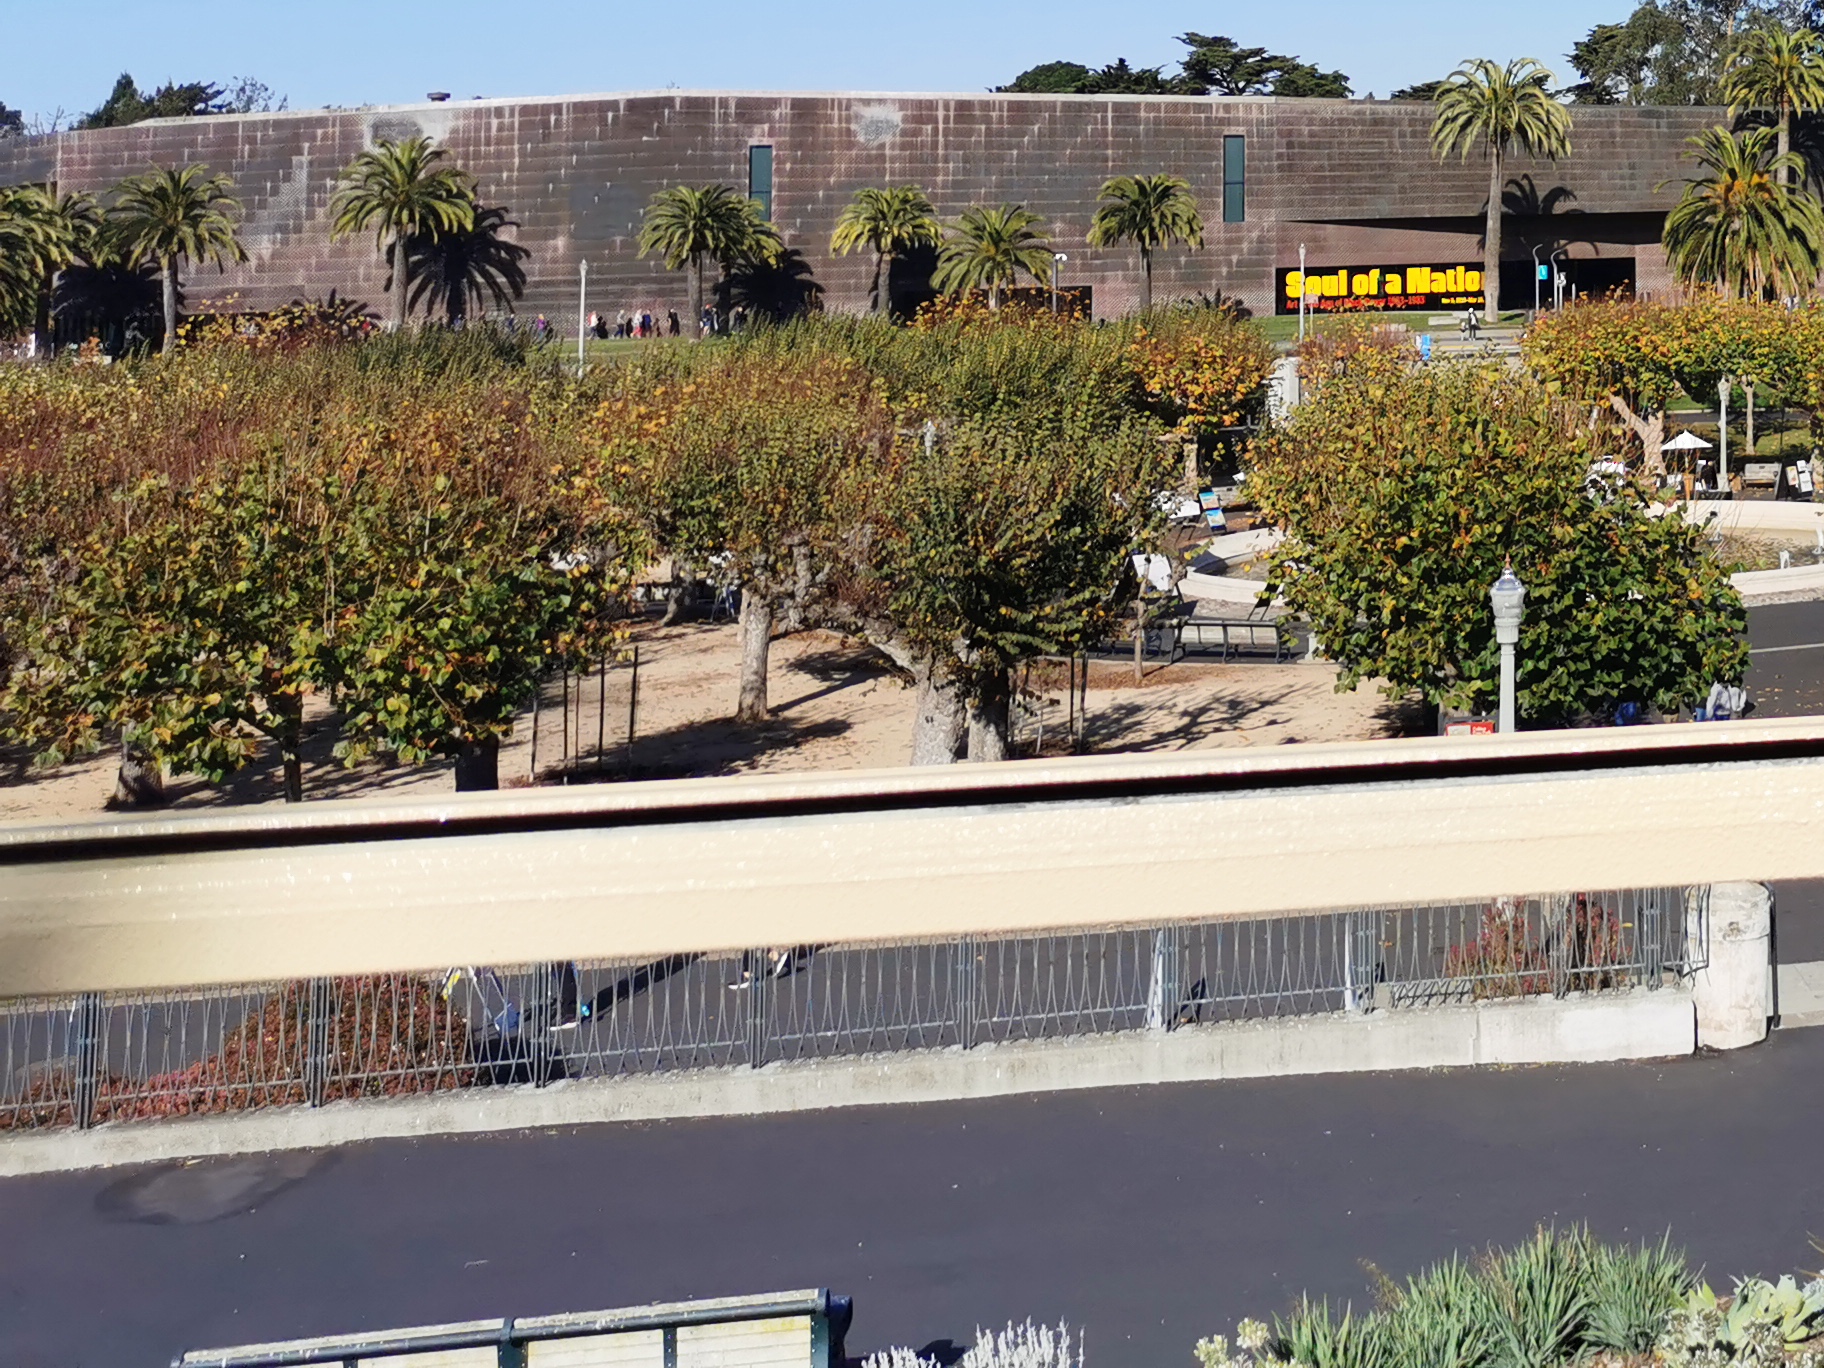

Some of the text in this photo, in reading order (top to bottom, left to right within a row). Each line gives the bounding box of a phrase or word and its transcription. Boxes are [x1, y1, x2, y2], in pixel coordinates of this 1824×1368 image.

[1286, 269, 1347, 298] Soul
[1352, 268, 1380, 295] of
[1385, 273, 1402, 294] a
